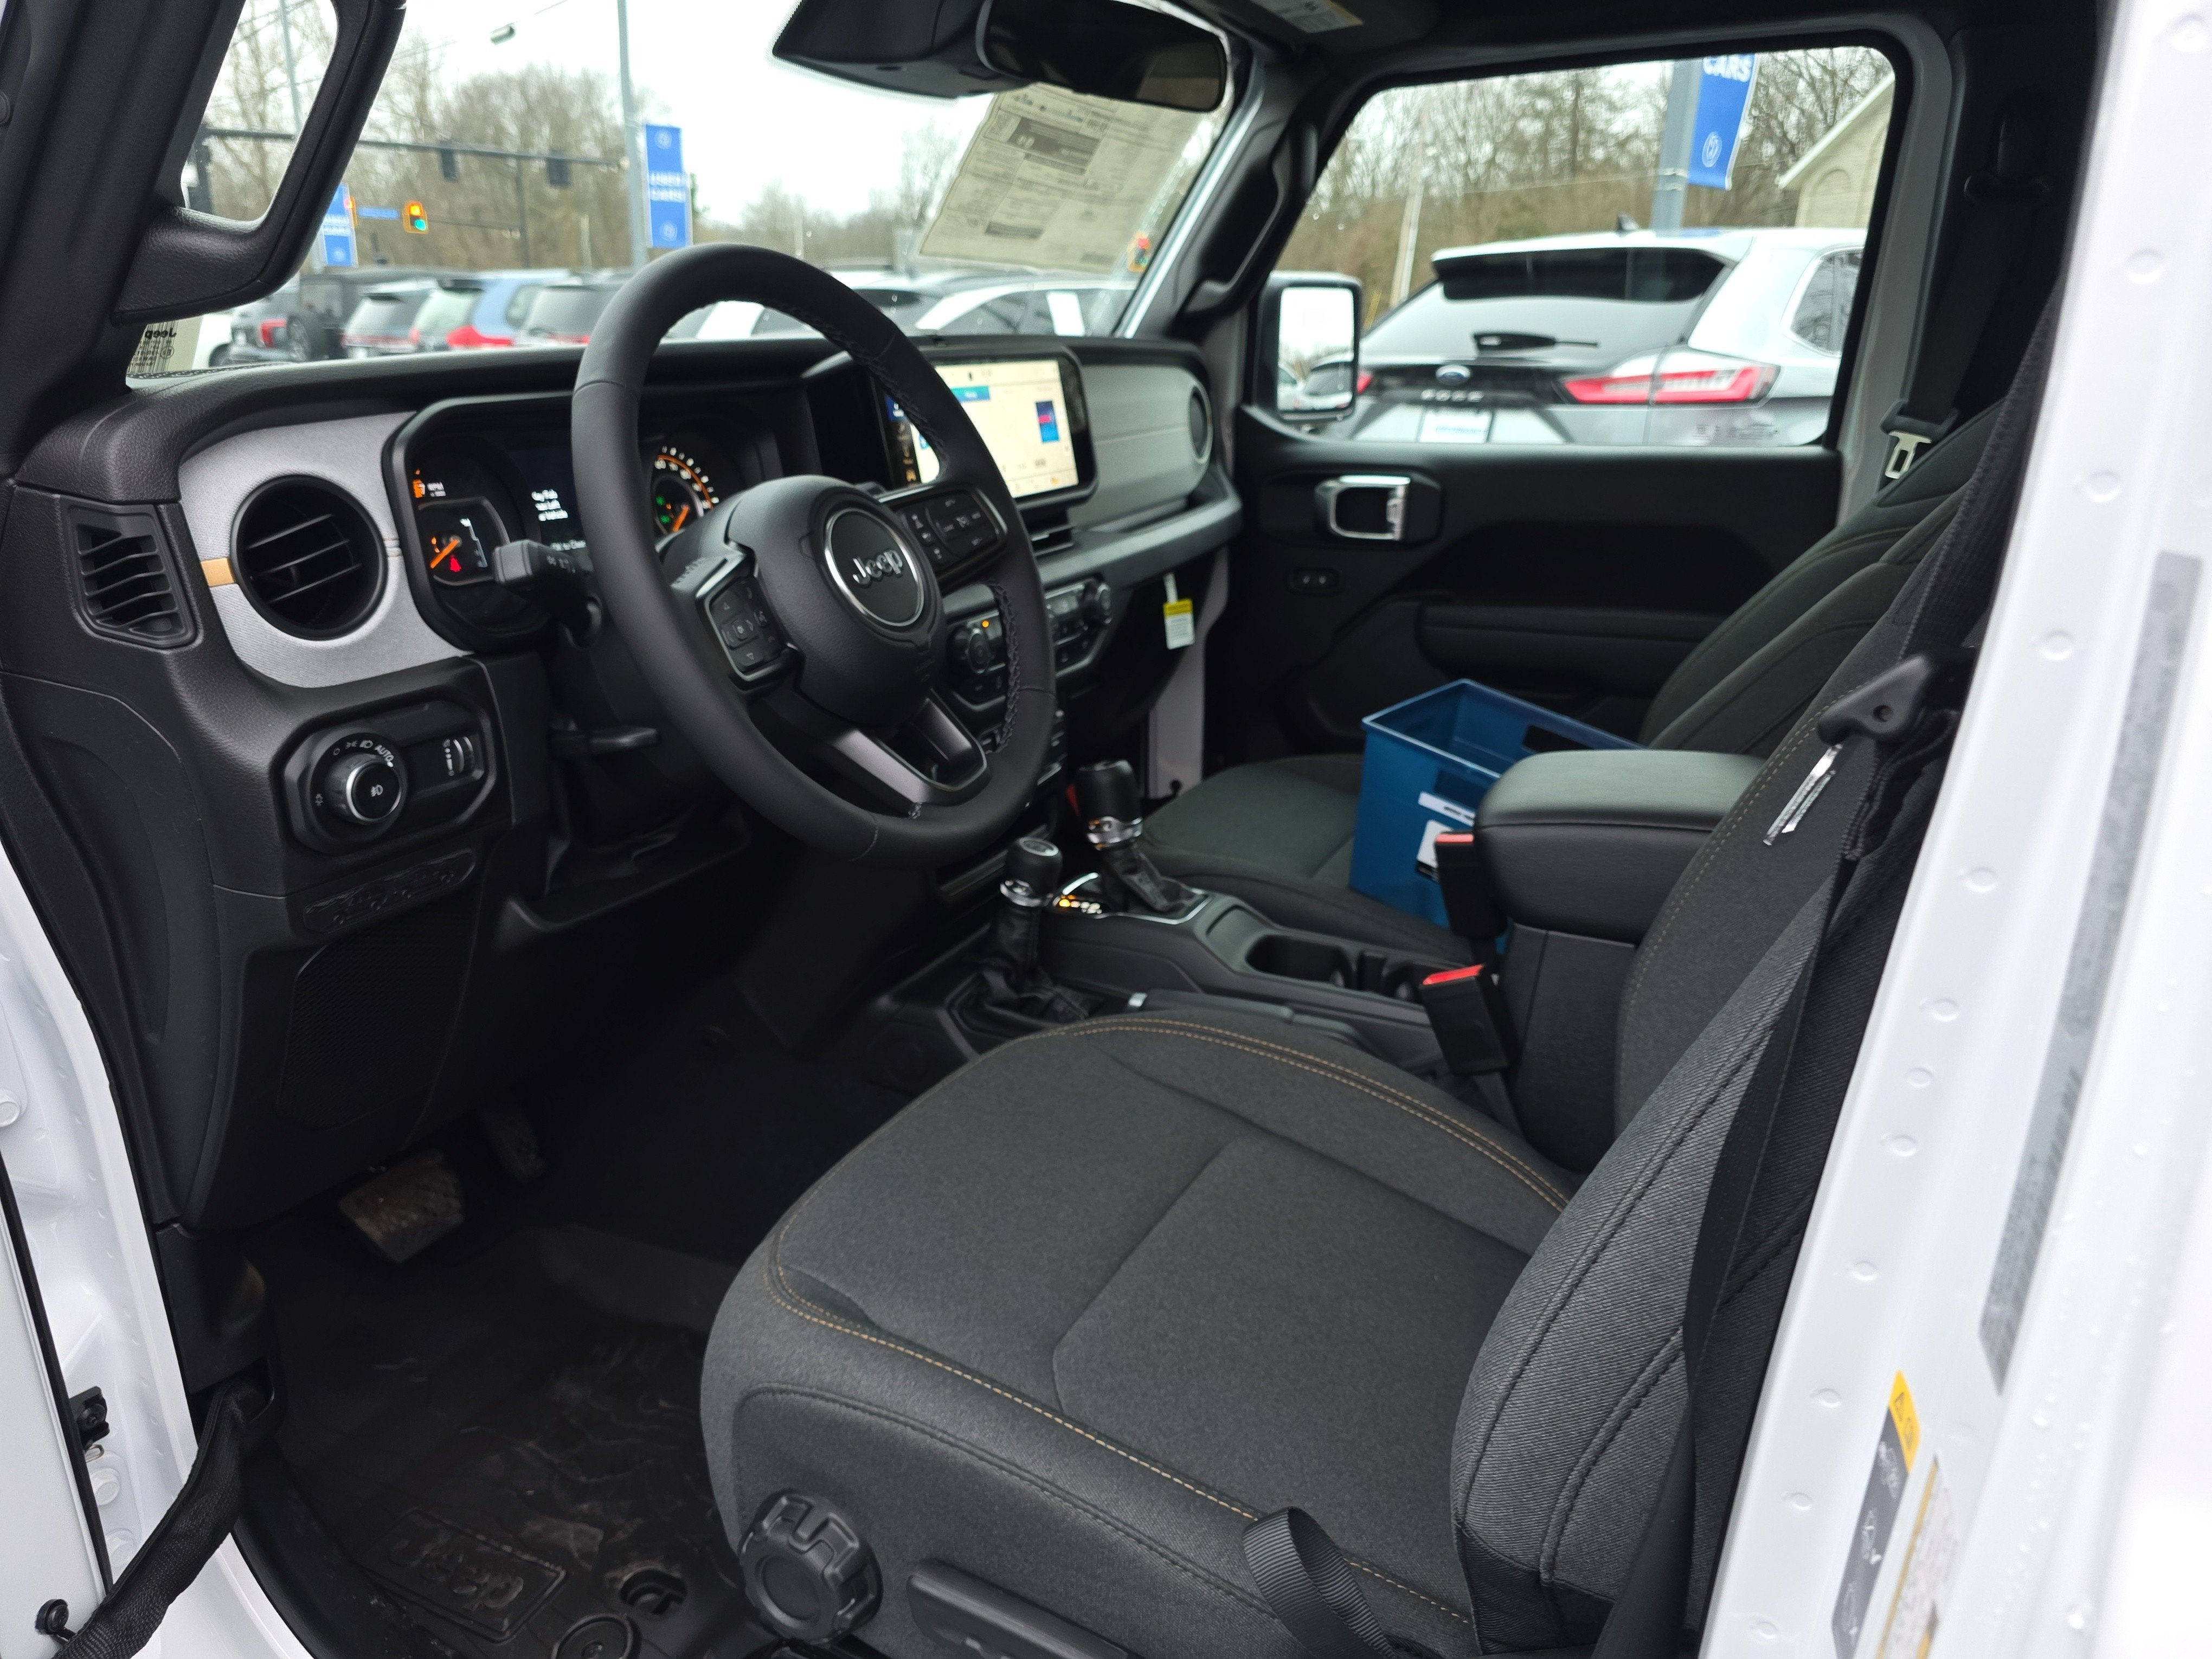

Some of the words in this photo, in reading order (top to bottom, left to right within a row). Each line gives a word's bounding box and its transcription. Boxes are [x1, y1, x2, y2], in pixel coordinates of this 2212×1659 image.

[1703, 55, 1751, 82] CARS
[852, 550, 903, 584] Jeep
[375, 744, 394, 762] AUTO
